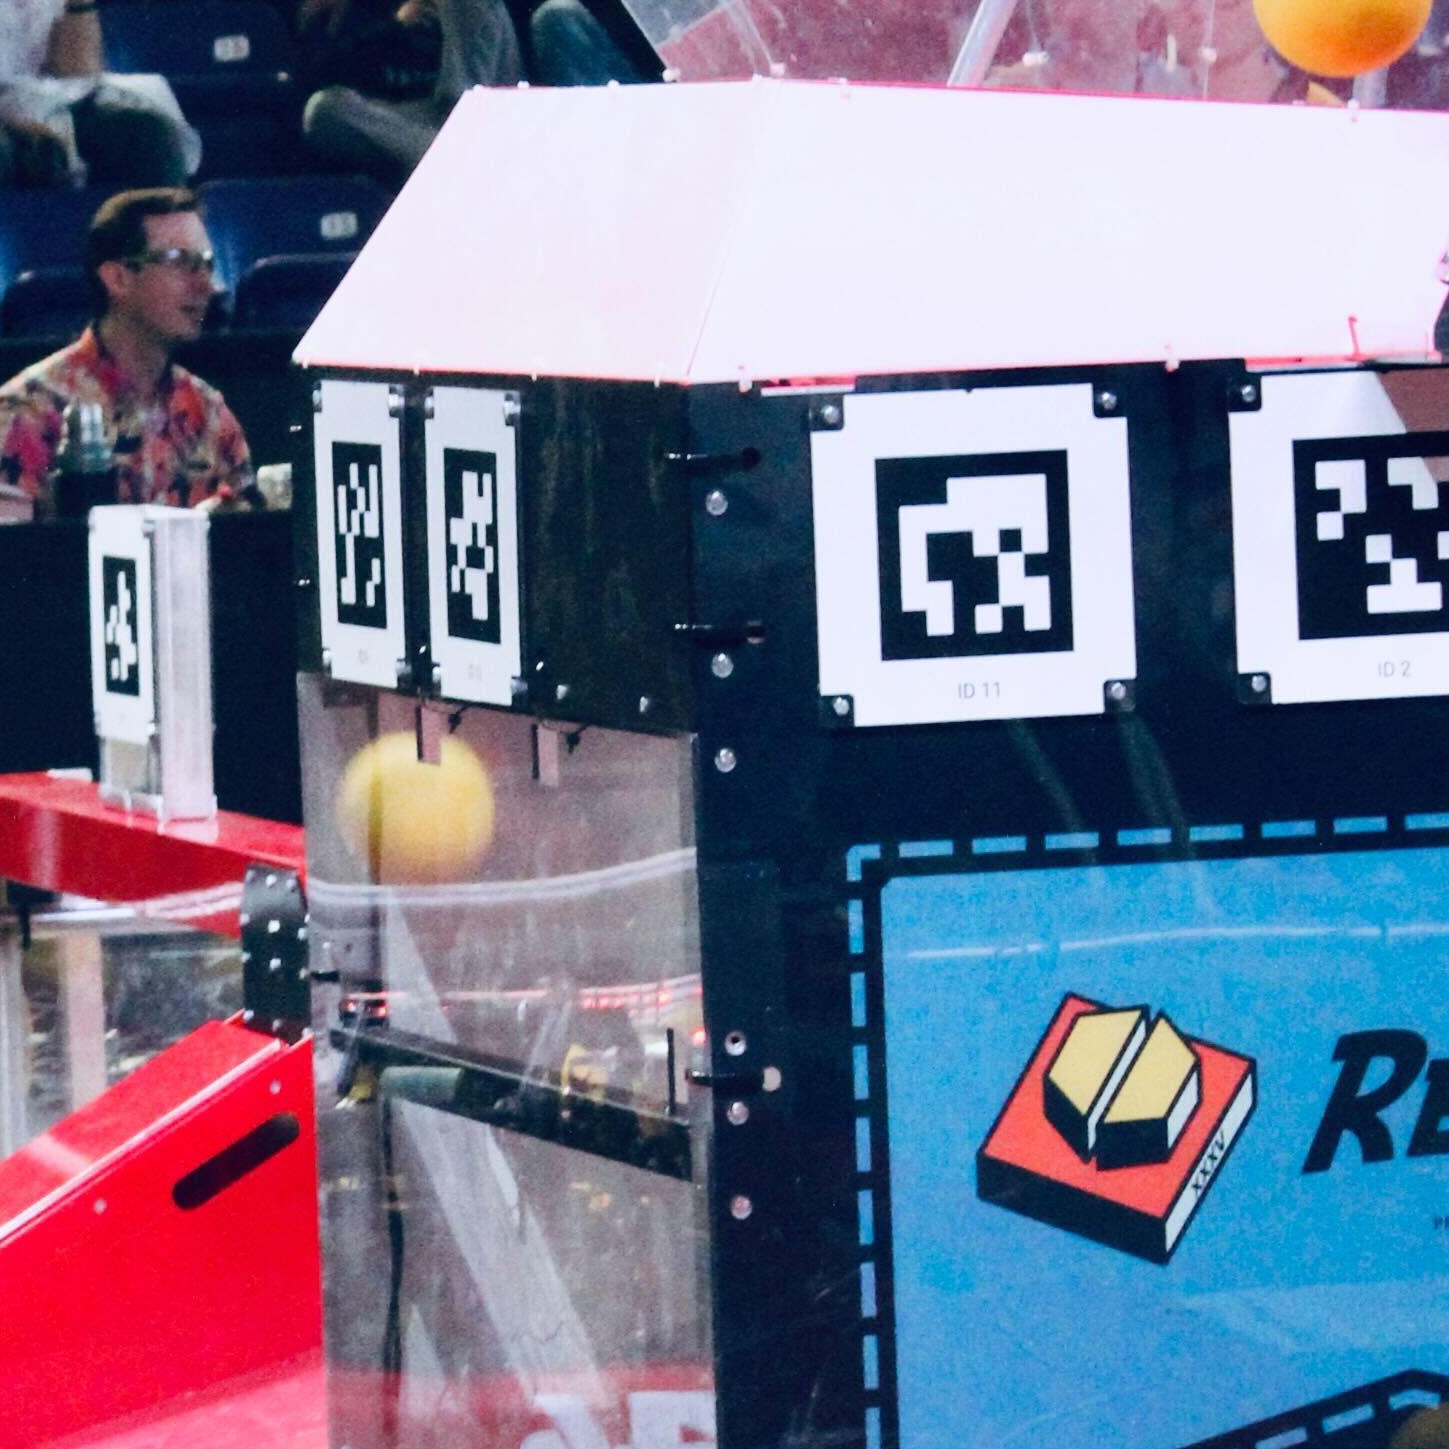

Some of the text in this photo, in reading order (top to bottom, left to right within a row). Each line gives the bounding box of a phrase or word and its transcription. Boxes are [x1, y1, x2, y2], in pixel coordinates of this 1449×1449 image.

[1377, 659, 1412, 678] ID 2
[957, 681, 1001, 700] ID 11
